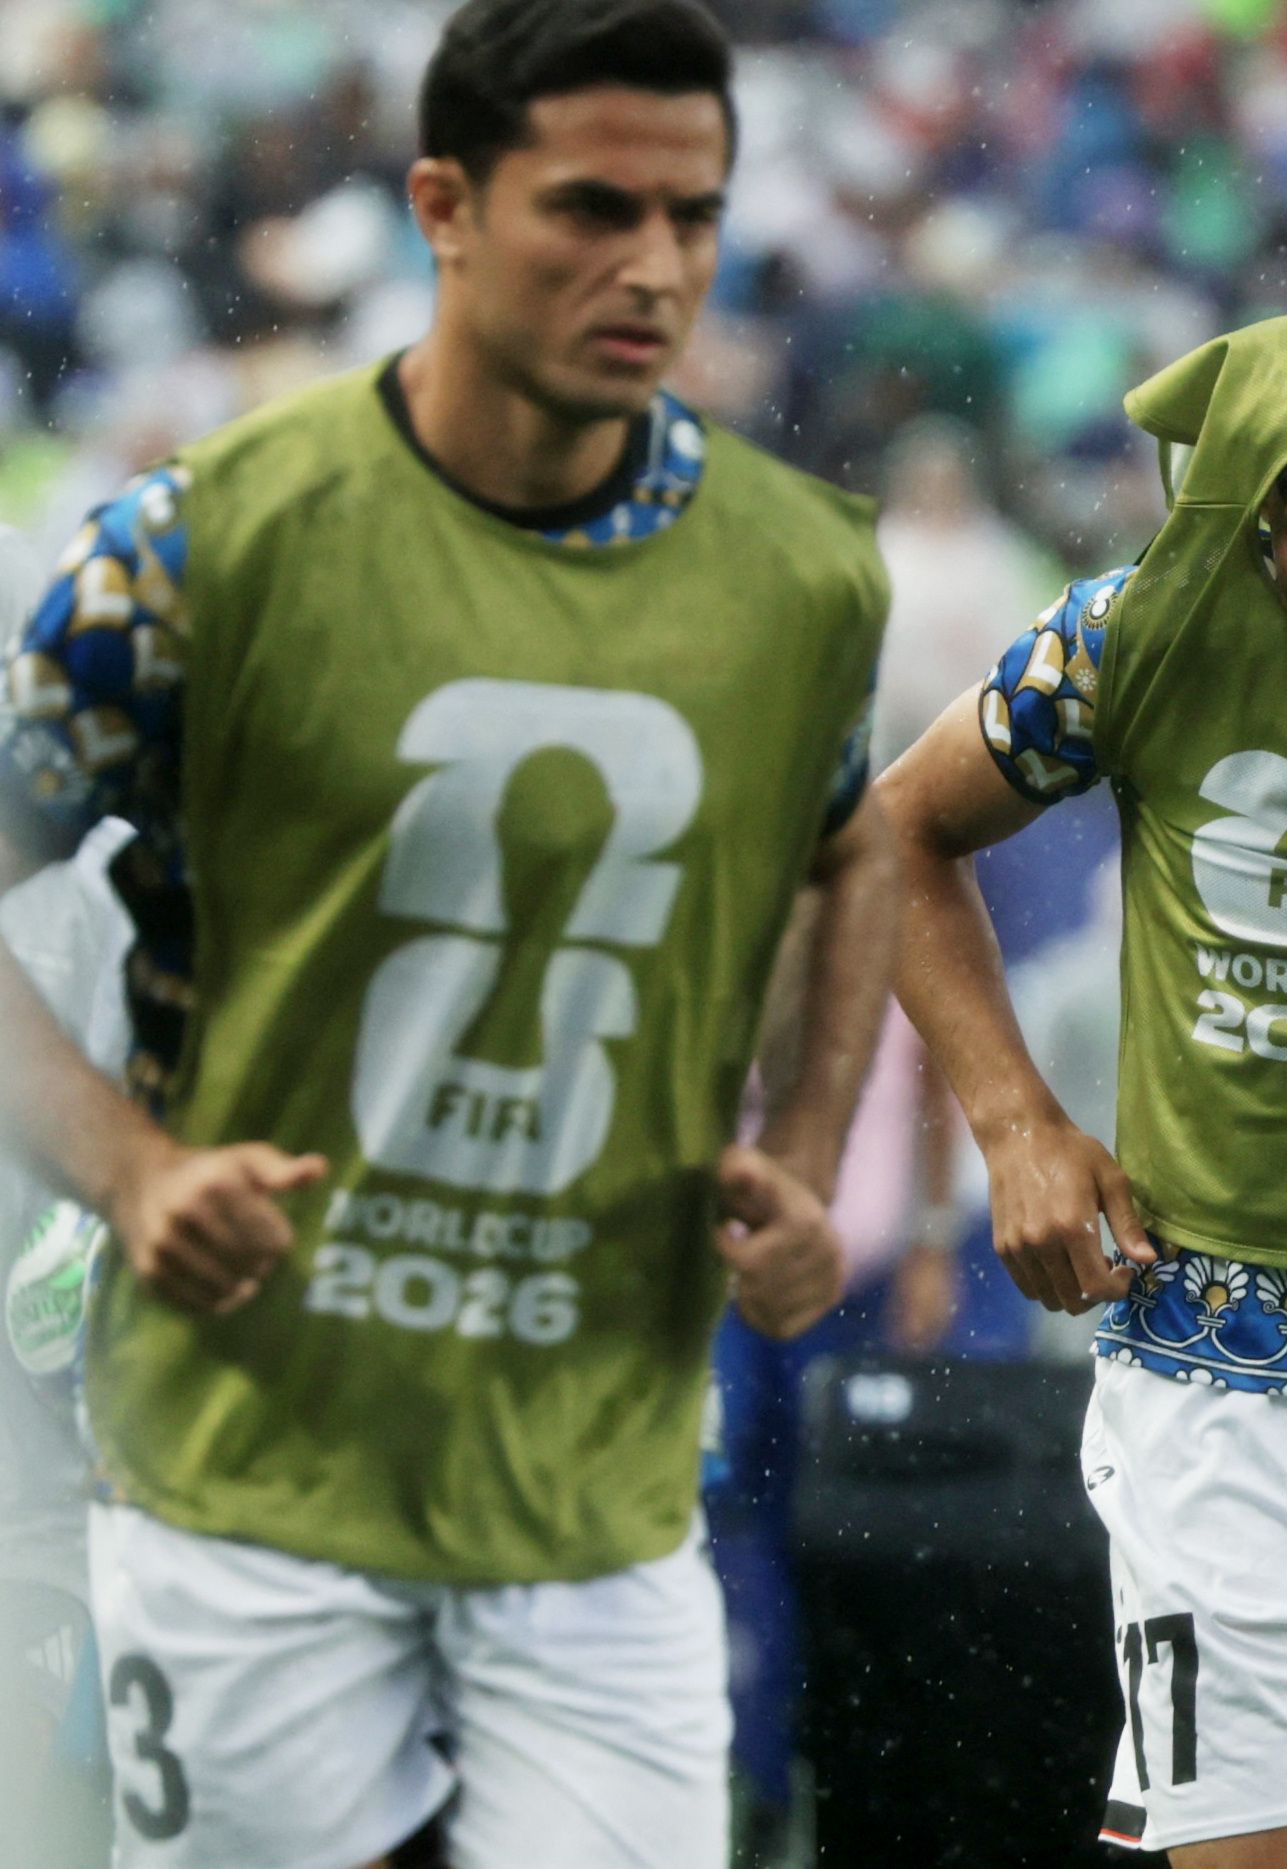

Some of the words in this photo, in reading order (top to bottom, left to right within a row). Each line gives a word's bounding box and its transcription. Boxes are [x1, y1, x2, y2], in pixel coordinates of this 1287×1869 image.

[304, 1243, 582, 1347] 2026
[109, 1653, 192, 1843] 3
[1122, 1612, 1199, 1792] 17
